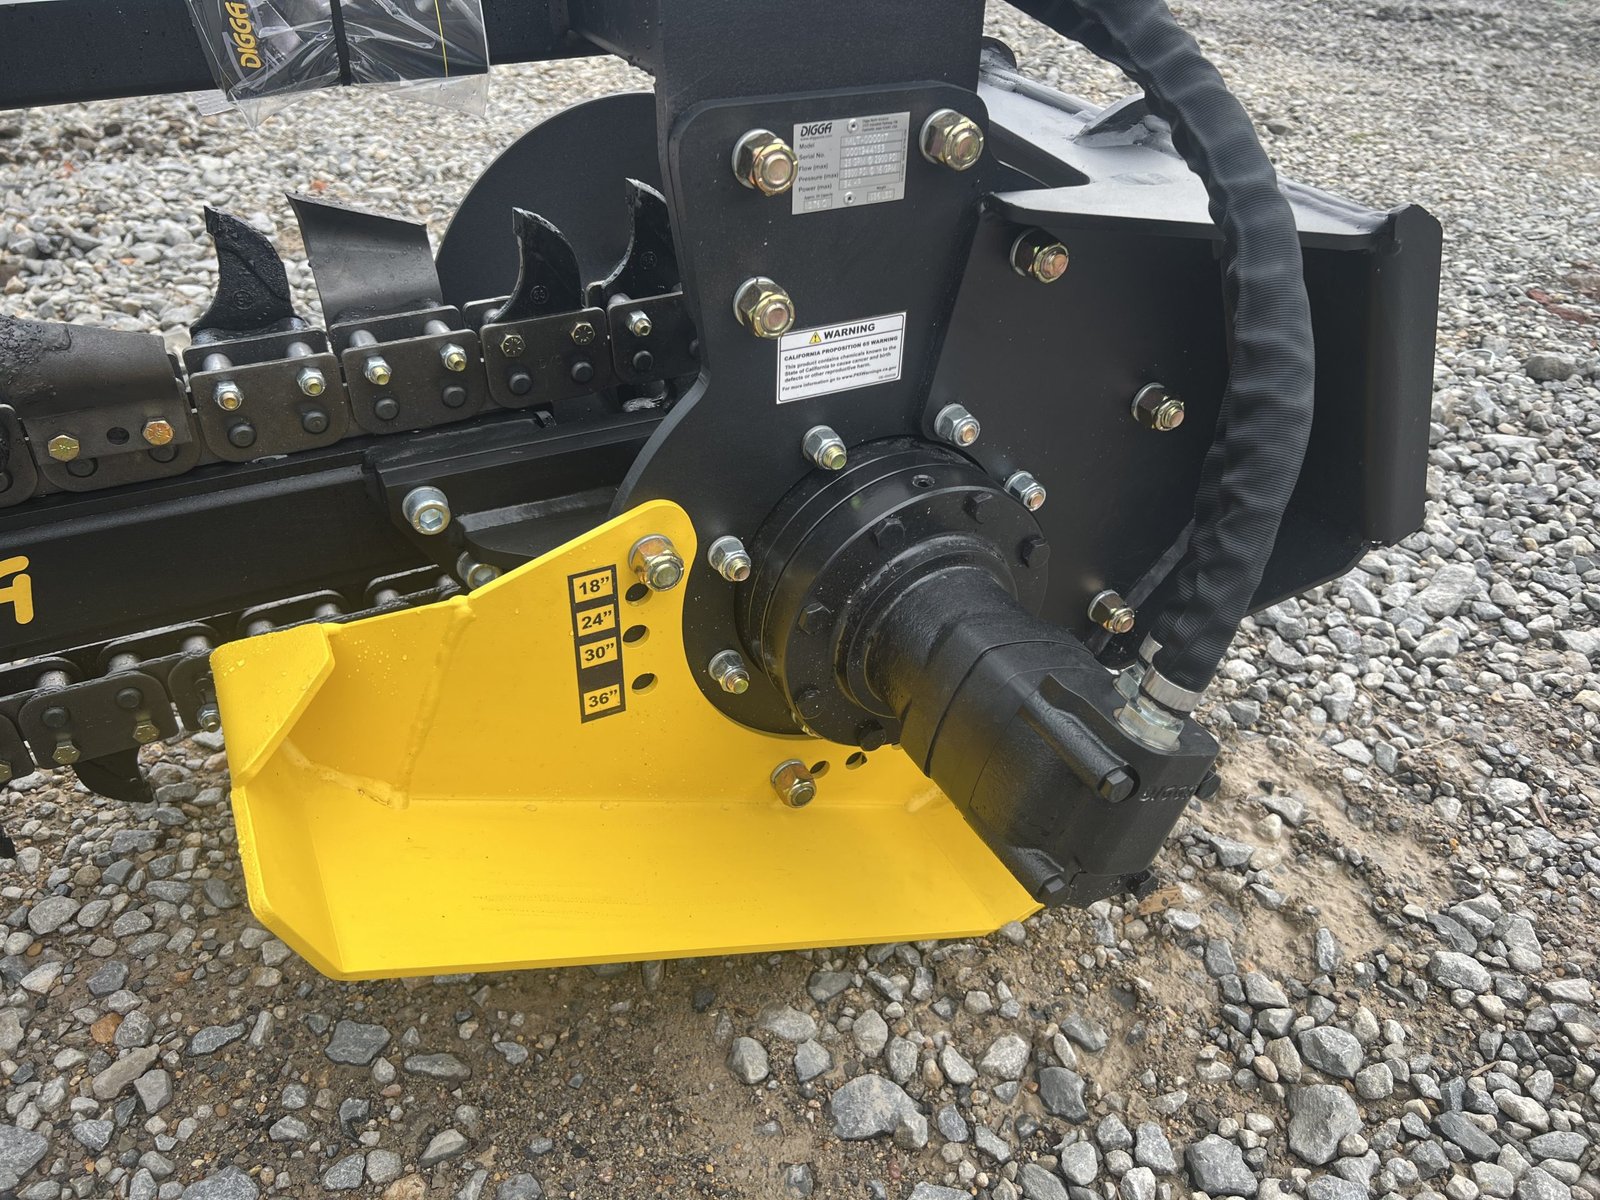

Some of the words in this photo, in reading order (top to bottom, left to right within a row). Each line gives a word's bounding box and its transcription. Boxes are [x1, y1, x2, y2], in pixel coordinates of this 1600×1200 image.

[225, 2, 262, 68] DIGGA
[801, 122, 832, 137] DIGGA
[813, 163, 828, 171] (max)
[823, 172, 838, 180] (max)
[824, 323, 875, 339] WARNING
[784, 351, 820, 361] CALIFORNIA
[822, 343, 861, 354] PROPOSITION
[871, 336, 898, 345] WARNING
[797, 360, 817, 369] product
[818, 356, 839, 364] contains
[840, 350, 865, 360] chemicals
[805, 364, 829, 373] California
[837, 359, 851, 367] cause
[785, 375, 803, 383] defects
[825, 365, 856, 376] reproductive
[803, 379, 829, 387] information
[579, 576, 610, 595] 18"
[581, 610, 612, 630] 24"
[584, 643, 615, 662] 30"
[588, 689, 618, 708] 36"
